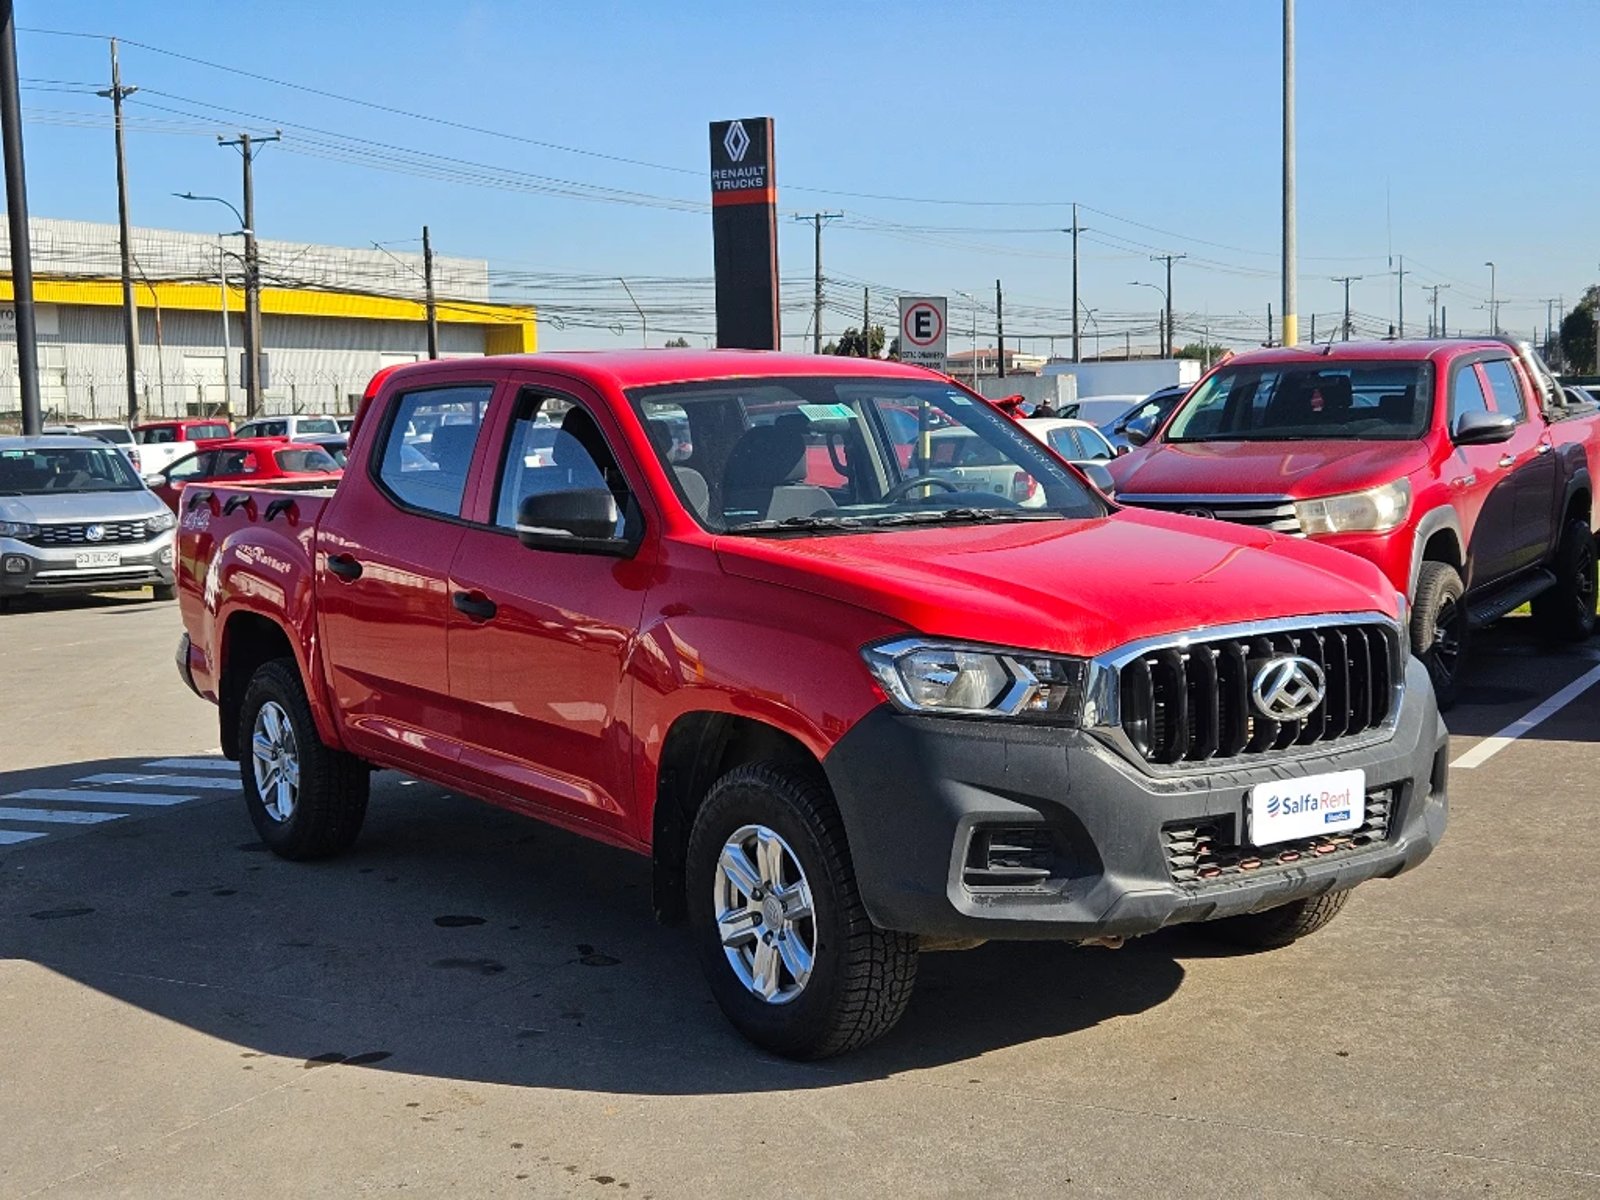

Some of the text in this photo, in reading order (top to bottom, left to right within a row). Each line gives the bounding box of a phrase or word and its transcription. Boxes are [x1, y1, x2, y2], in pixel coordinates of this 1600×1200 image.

[712, 166, 766, 180] RENAULT
[715, 177, 764, 190] TRUCKS
[915, 311, 932, 338] E
